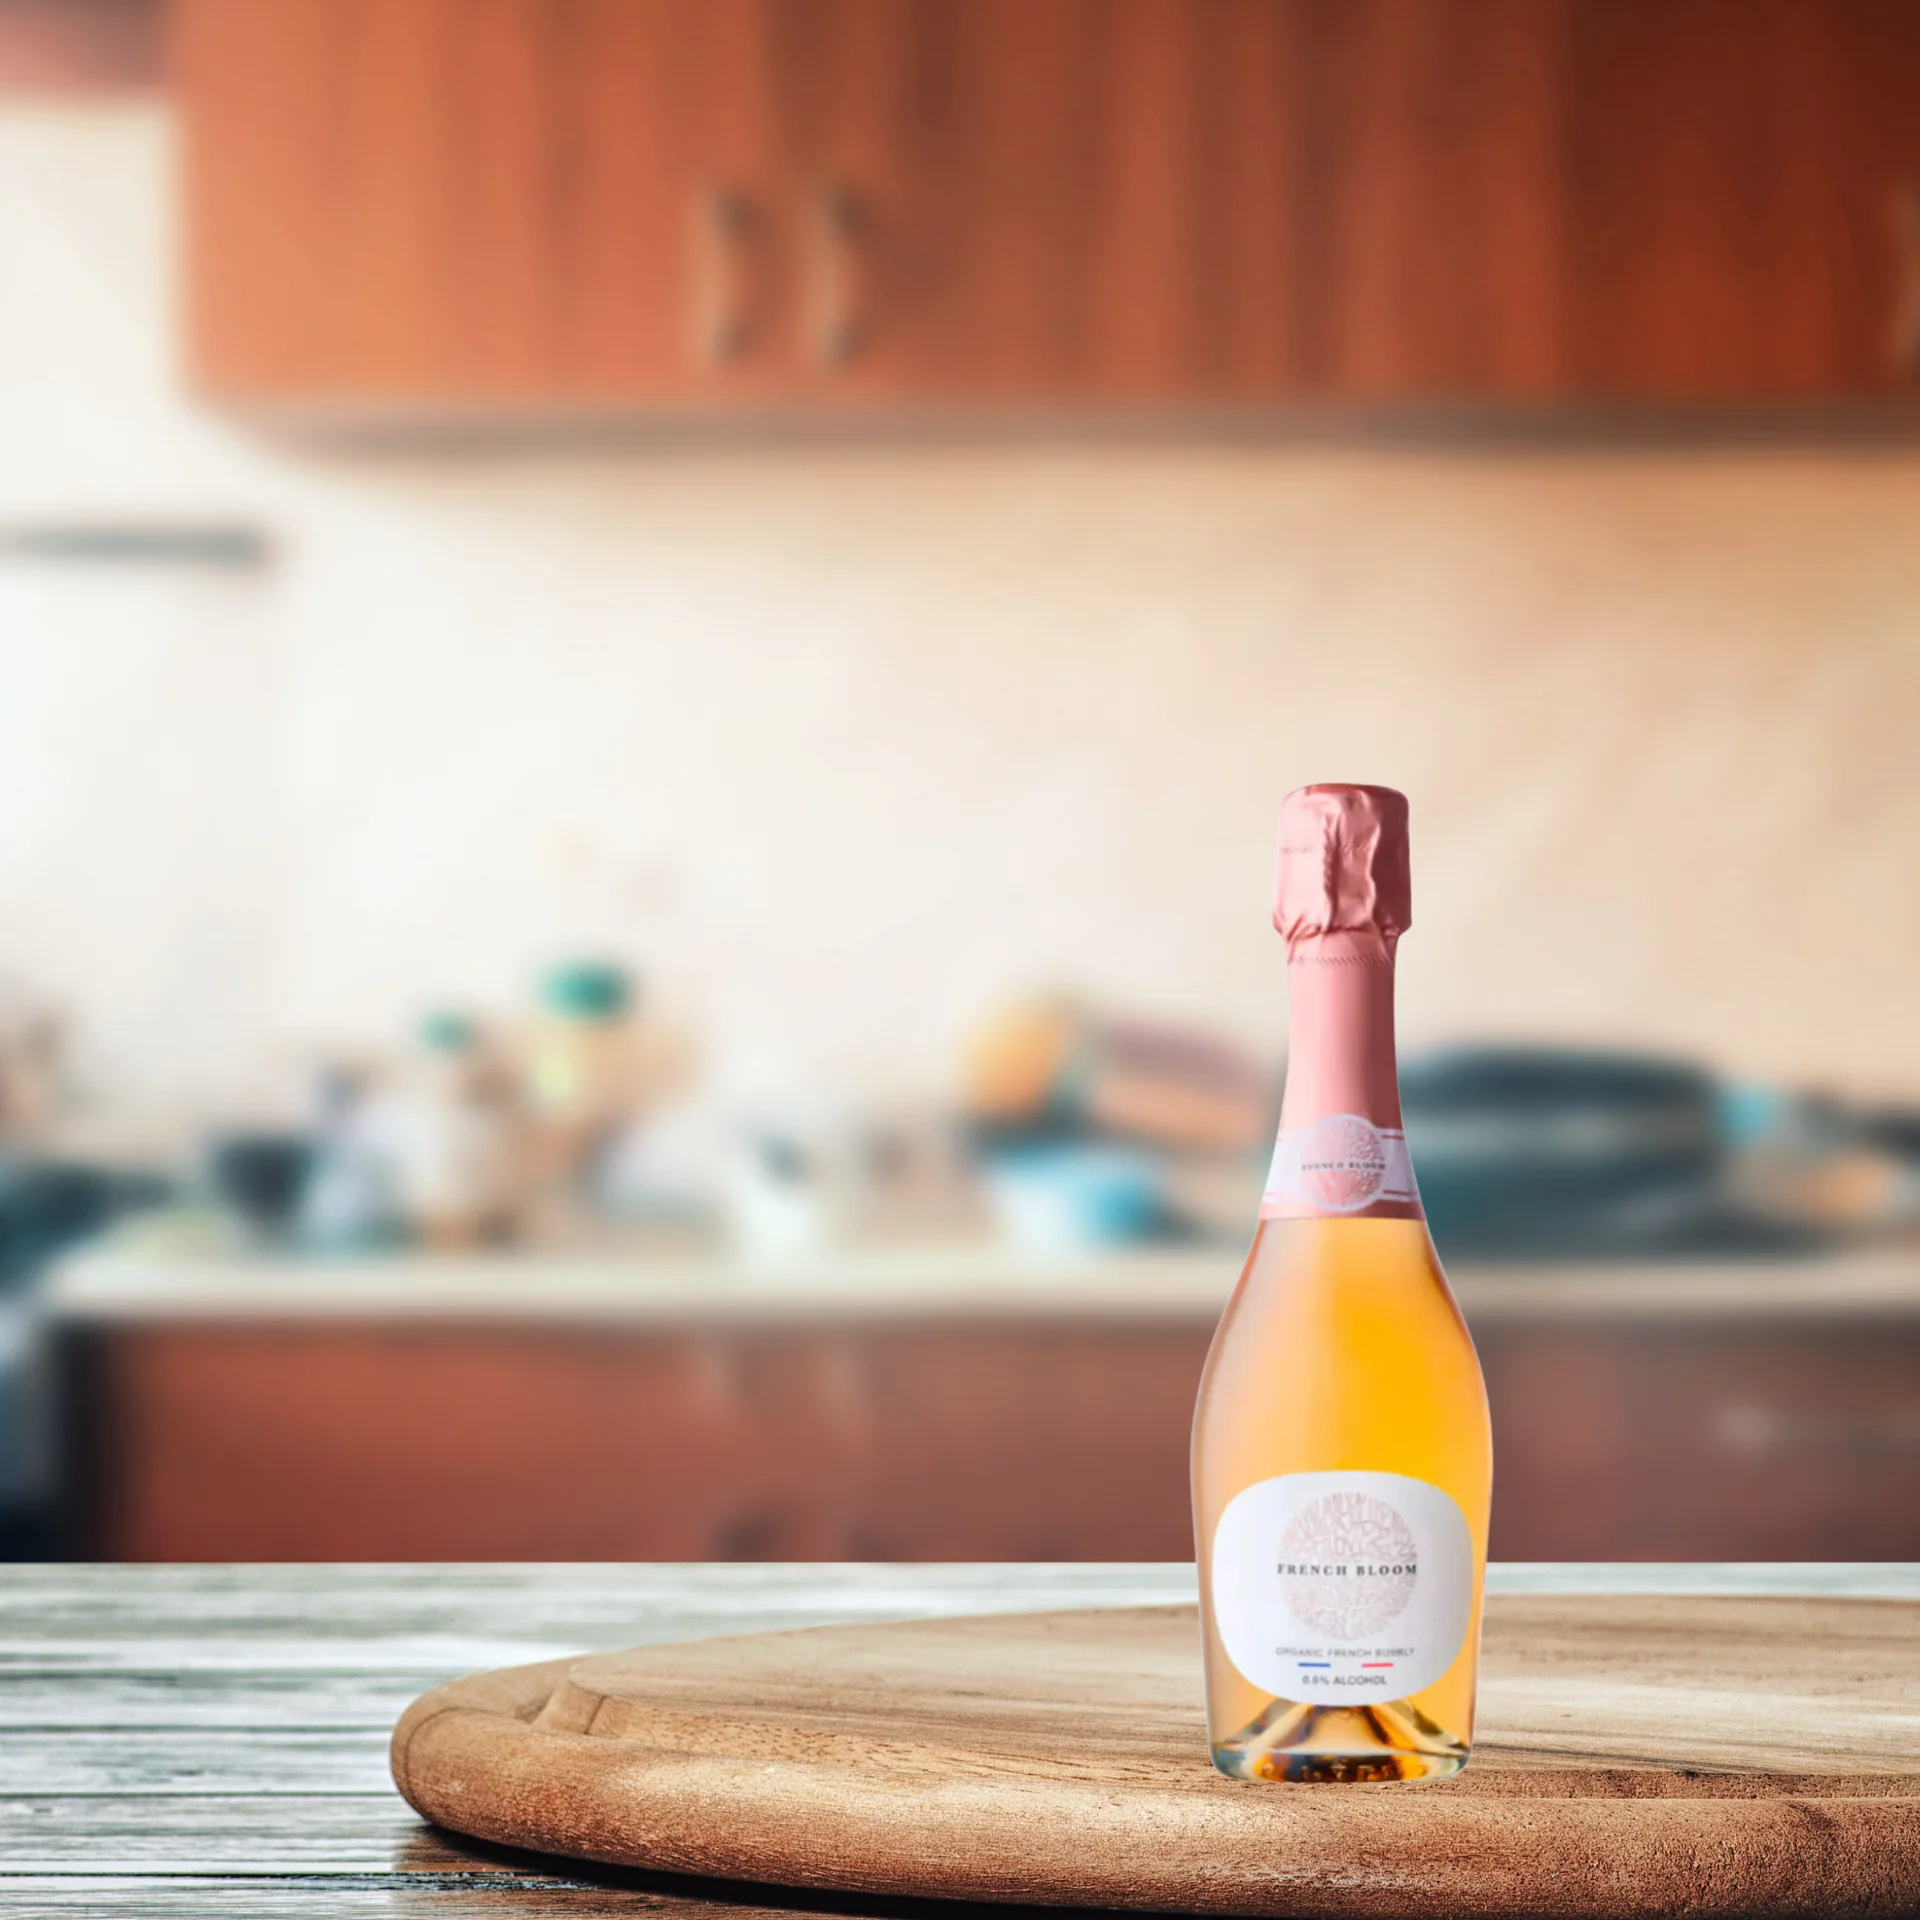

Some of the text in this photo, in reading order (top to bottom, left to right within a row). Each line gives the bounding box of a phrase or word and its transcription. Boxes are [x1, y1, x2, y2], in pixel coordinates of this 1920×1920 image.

[1277, 1564, 1417, 1576] FRENCH BLOOM
[1275, 1647, 1415, 1658] ORGANIC FRENCH BUBBLY
[1333, 1675, 1387, 1686] ALCOHOL
